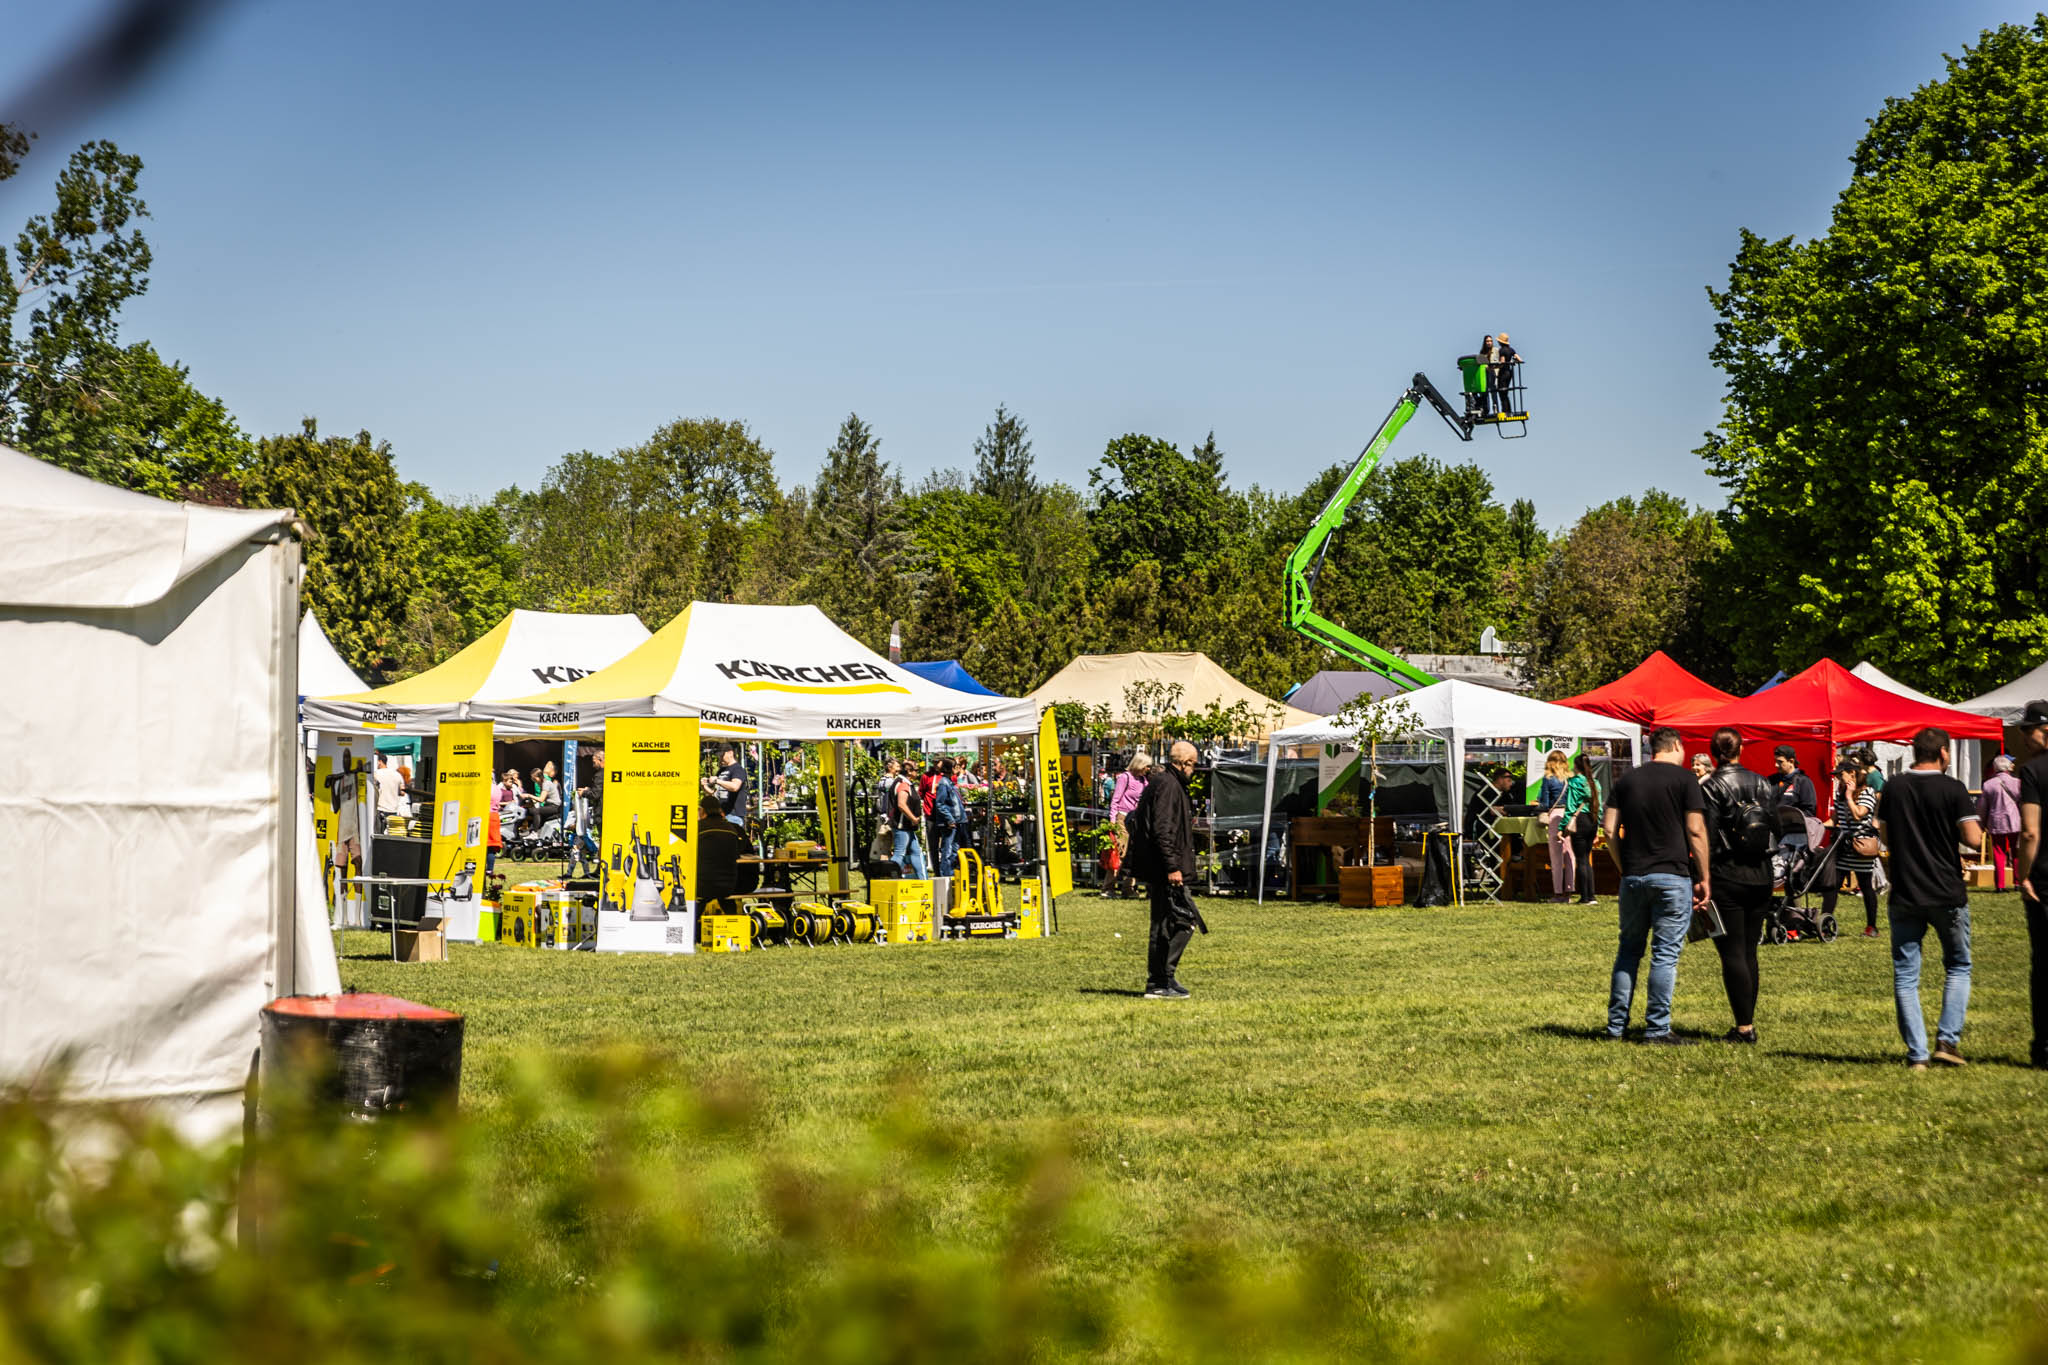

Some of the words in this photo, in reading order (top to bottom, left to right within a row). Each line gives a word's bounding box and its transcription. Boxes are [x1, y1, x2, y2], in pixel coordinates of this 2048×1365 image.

[714, 659, 897, 683] KÄRCHER
[539, 711, 580, 723] KÄRCHER
[700, 709, 758, 726] KÄRCHER
[827, 718, 882, 729] KÄRCHER
[944, 711, 998, 726] KÄRCHER
[613, 773, 621, 781] 2
[674, 806, 684, 819] 5
[1047, 758, 1068, 853] KÄRCHER
